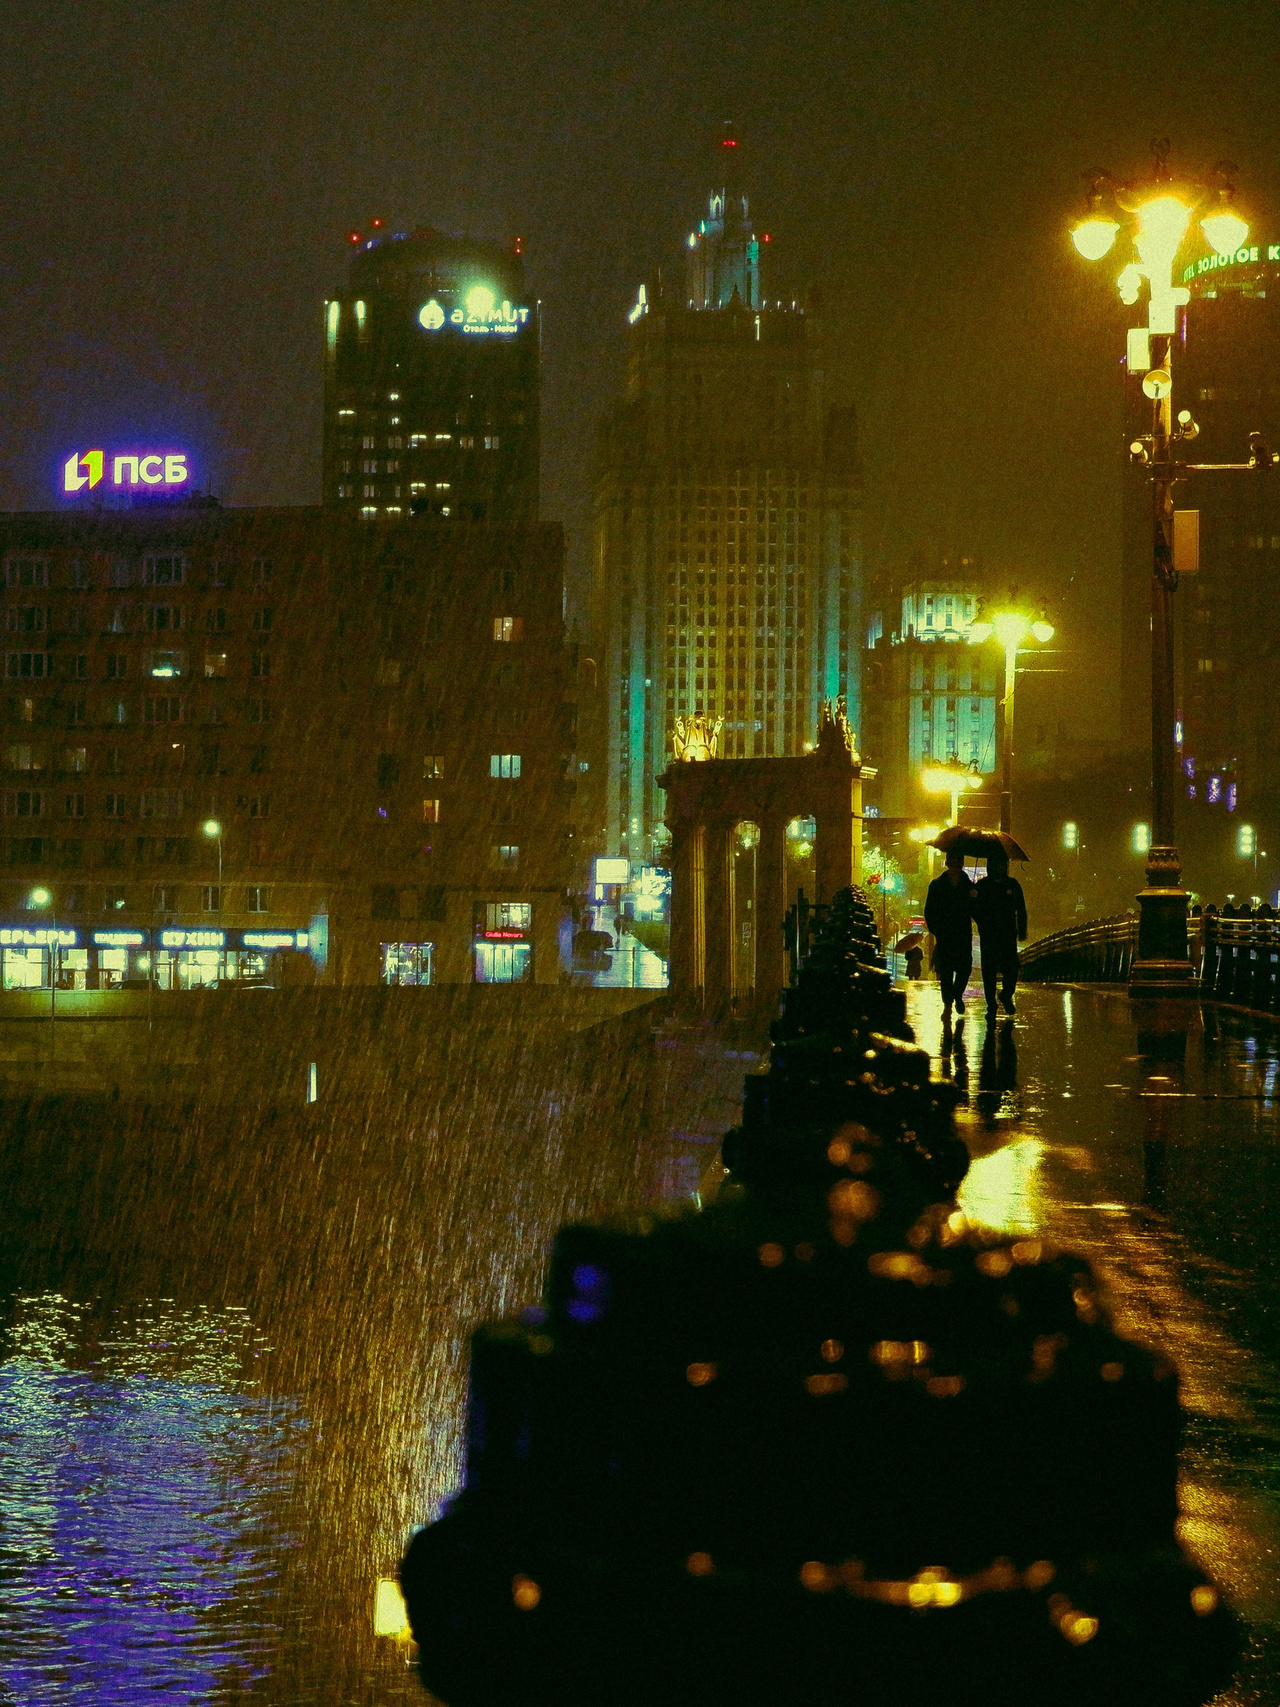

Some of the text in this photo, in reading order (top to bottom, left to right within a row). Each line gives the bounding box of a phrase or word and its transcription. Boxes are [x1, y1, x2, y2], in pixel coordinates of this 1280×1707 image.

[1197, 247, 1259, 274] ЗОЛОТОЕ
[113, 455, 188, 485] ПСБ
[162, 931, 224, 946] КУХНИ
